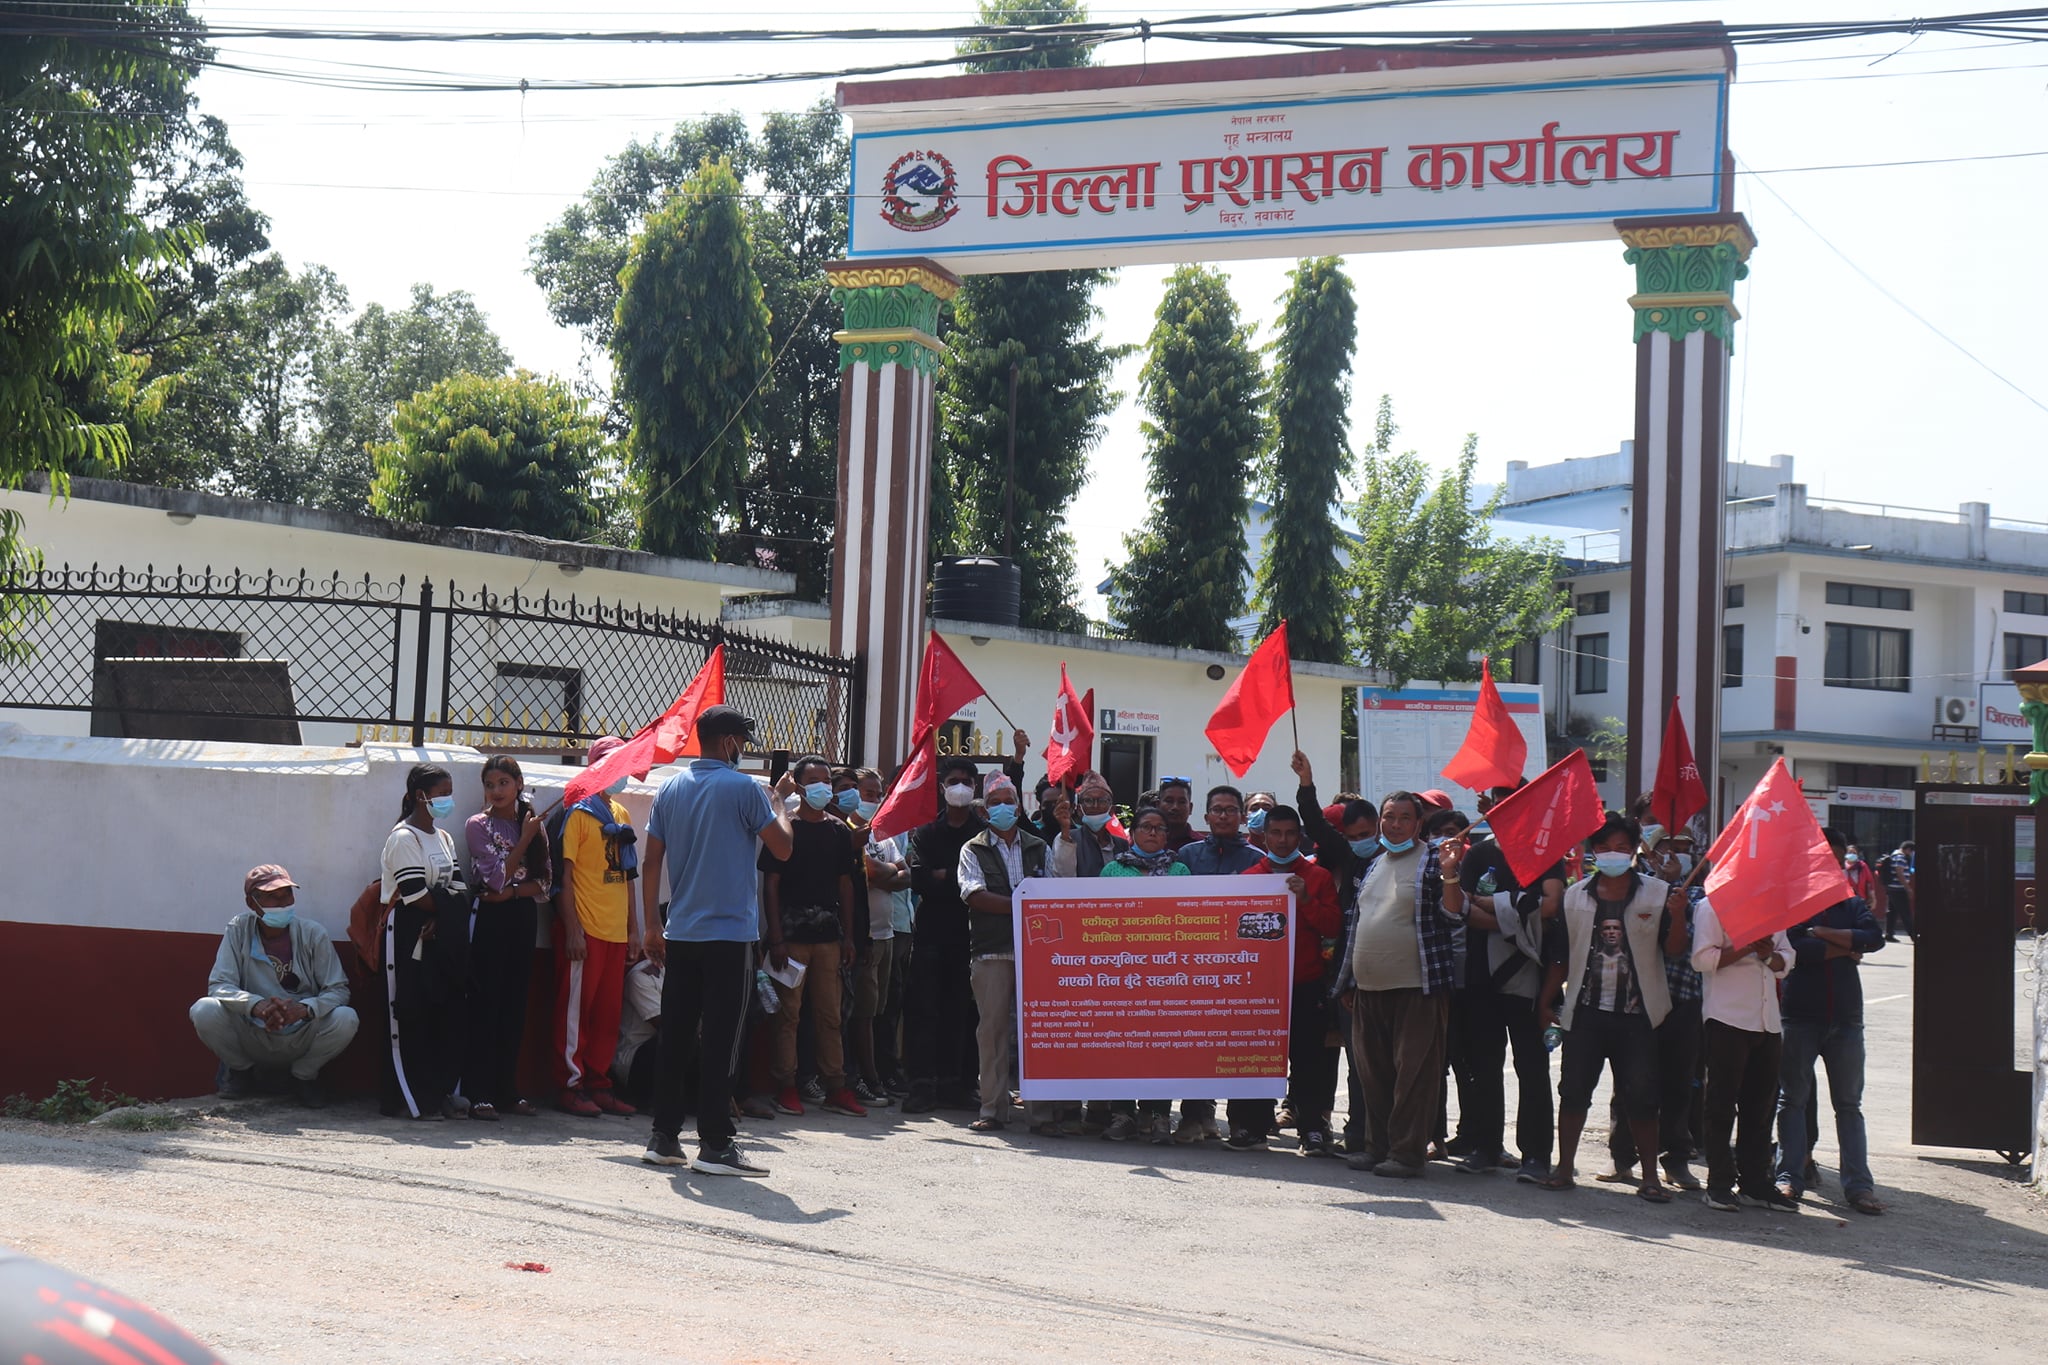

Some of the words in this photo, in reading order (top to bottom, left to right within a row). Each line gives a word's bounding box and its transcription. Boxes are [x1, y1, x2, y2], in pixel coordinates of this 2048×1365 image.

[1231, 115, 1252, 125] नेपाल
[1256, 114, 1286, 124] सरकार
[1223, 133, 1240, 150] गृह
[1246, 130, 1293, 143] मन्त्रालय
[986, 154, 1162, 217] जिल्ला
[1179, 146, 1389, 212] प्रशासन
[1408, 122, 1681, 190] कार्यालय
[1117, 722, 1139, 732] Ladies
[1141, 723, 1160, 733] Toilet
[1051, 952, 1086, 966] नेपाल
[1152, 952, 1177, 965] पार्टी
[1181, 953, 1190, 965] र
[1058, 973, 1094, 987] भएको
[1097, 973, 1121, 987] तिन
[1146, 972, 1189, 987] सहमति
[1192, 975, 1220, 988] लागु
[1223, 974, 1242, 985] गर
